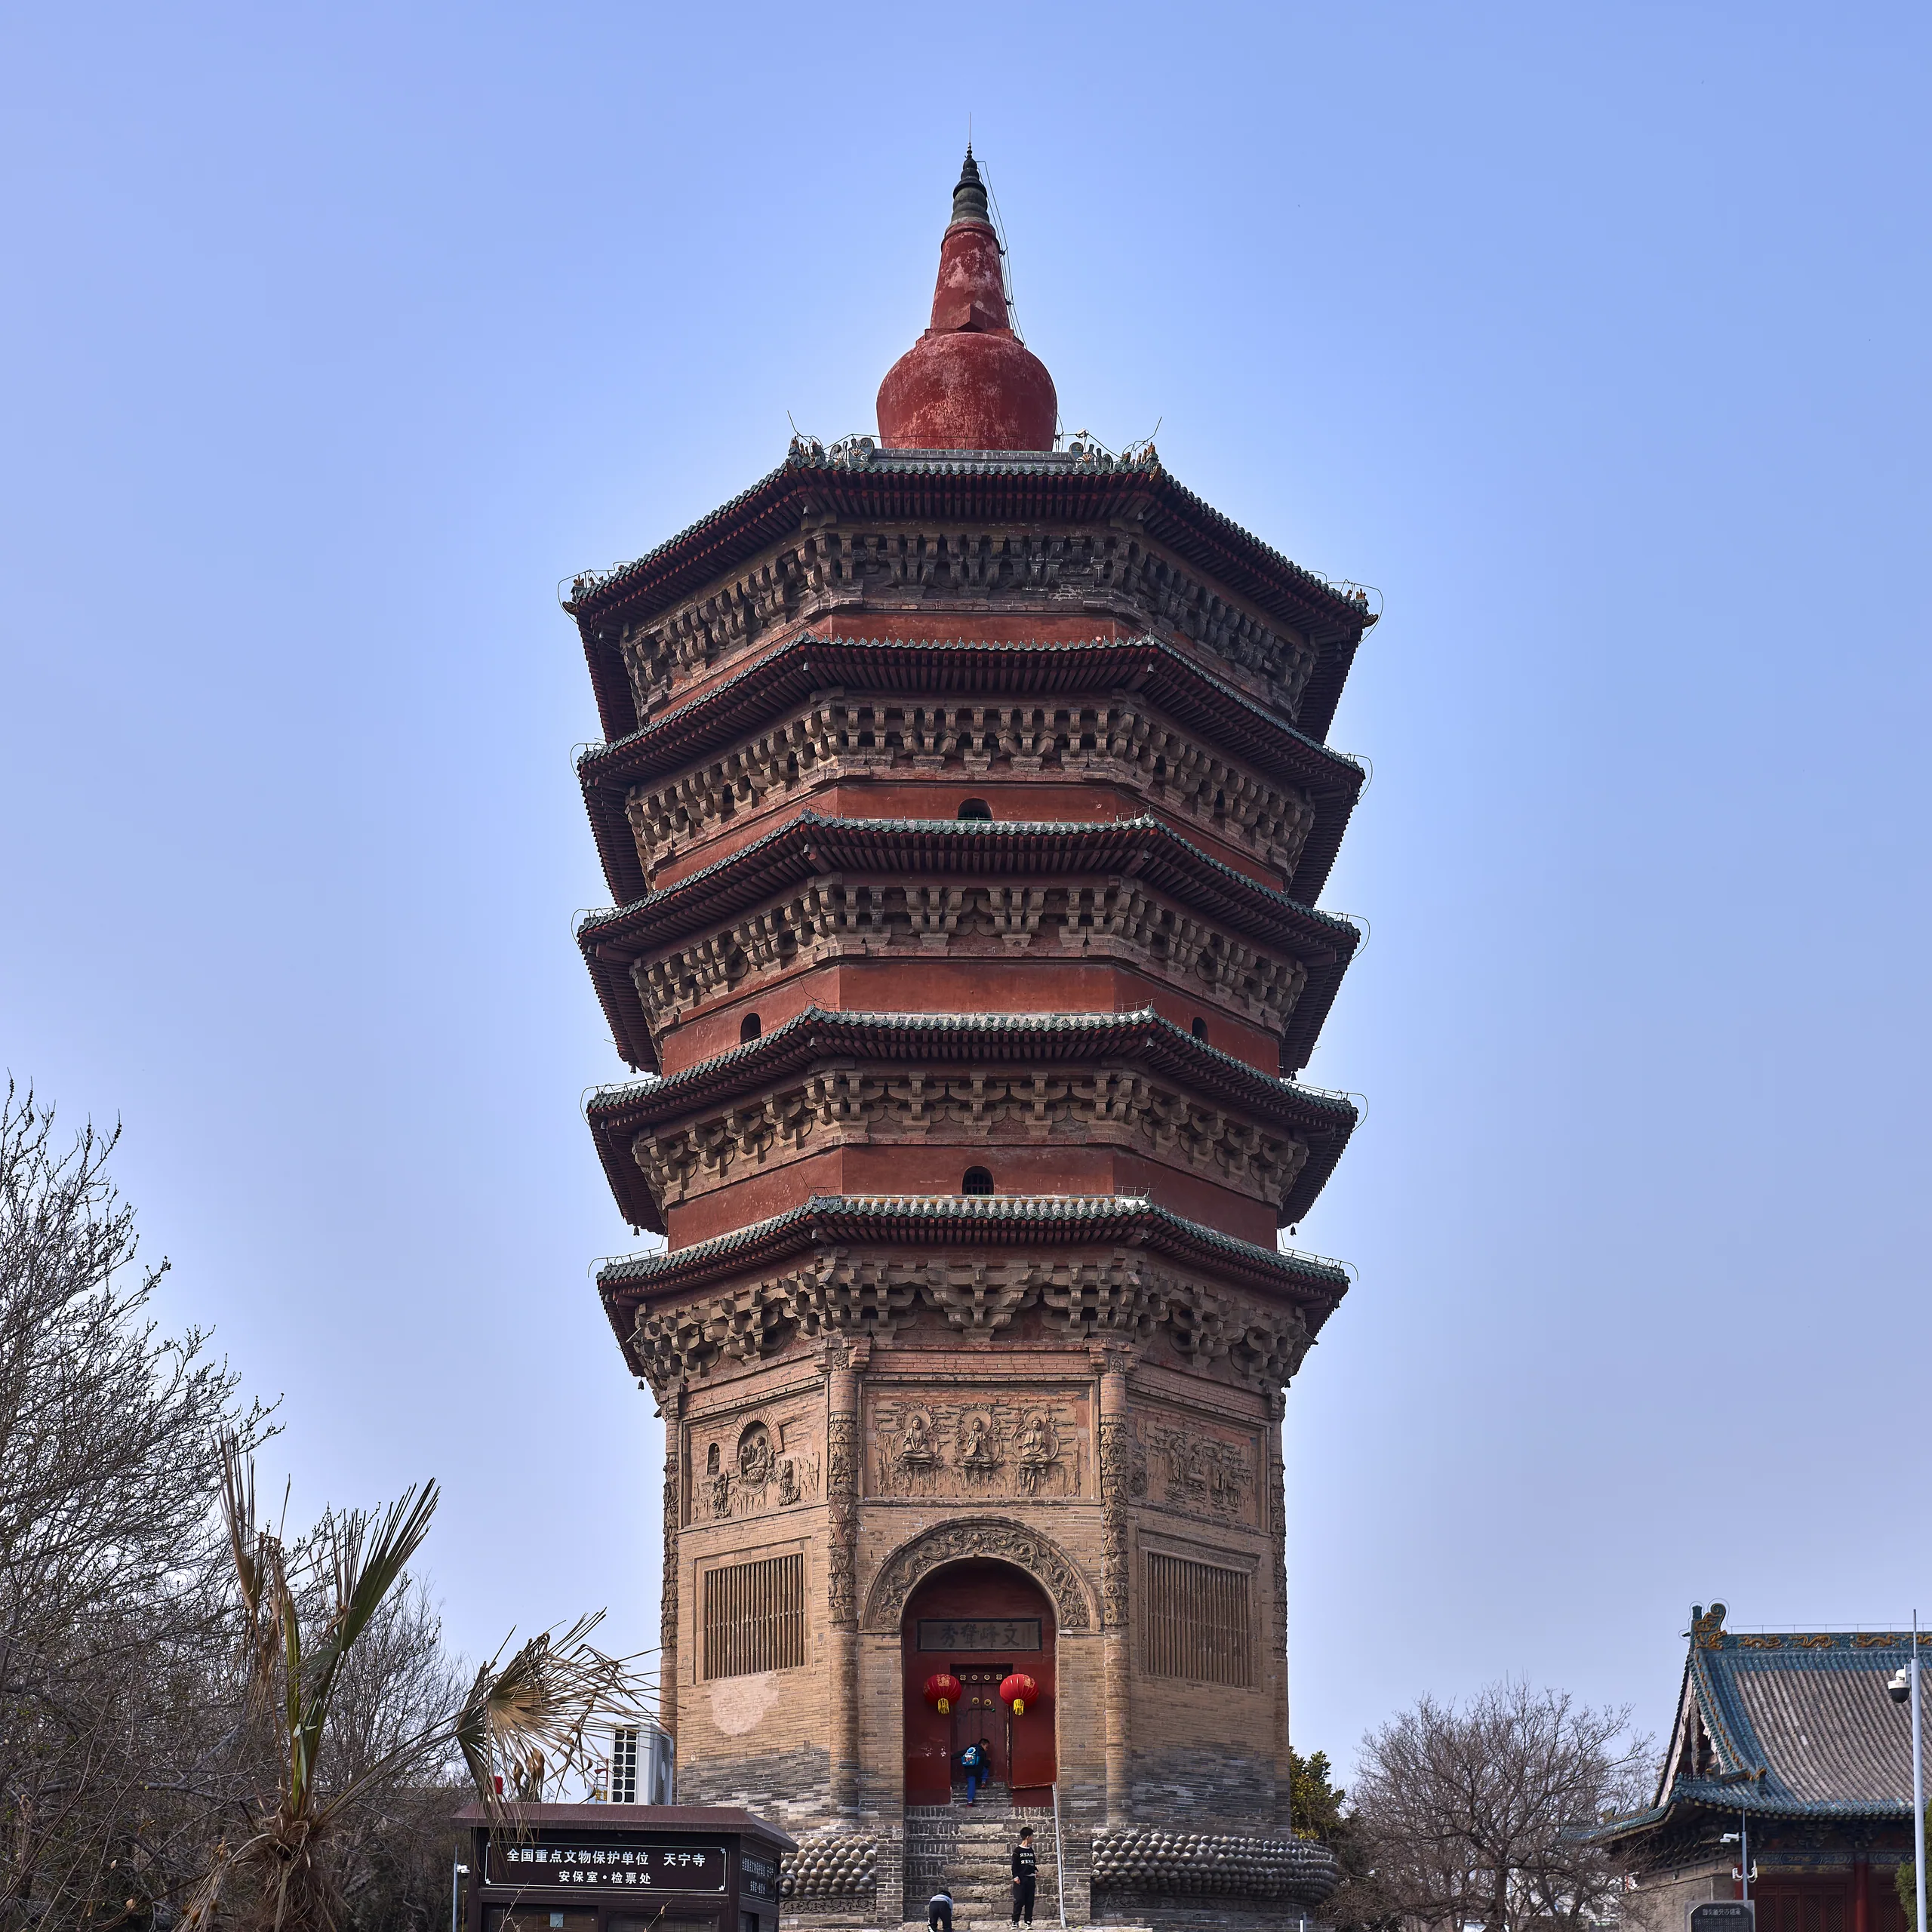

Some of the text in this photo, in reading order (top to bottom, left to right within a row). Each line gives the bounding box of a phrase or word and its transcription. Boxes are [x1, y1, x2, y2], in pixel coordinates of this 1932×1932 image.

[506, 1848, 706, 1867] 全国重点文物保护单位 天宁寺
